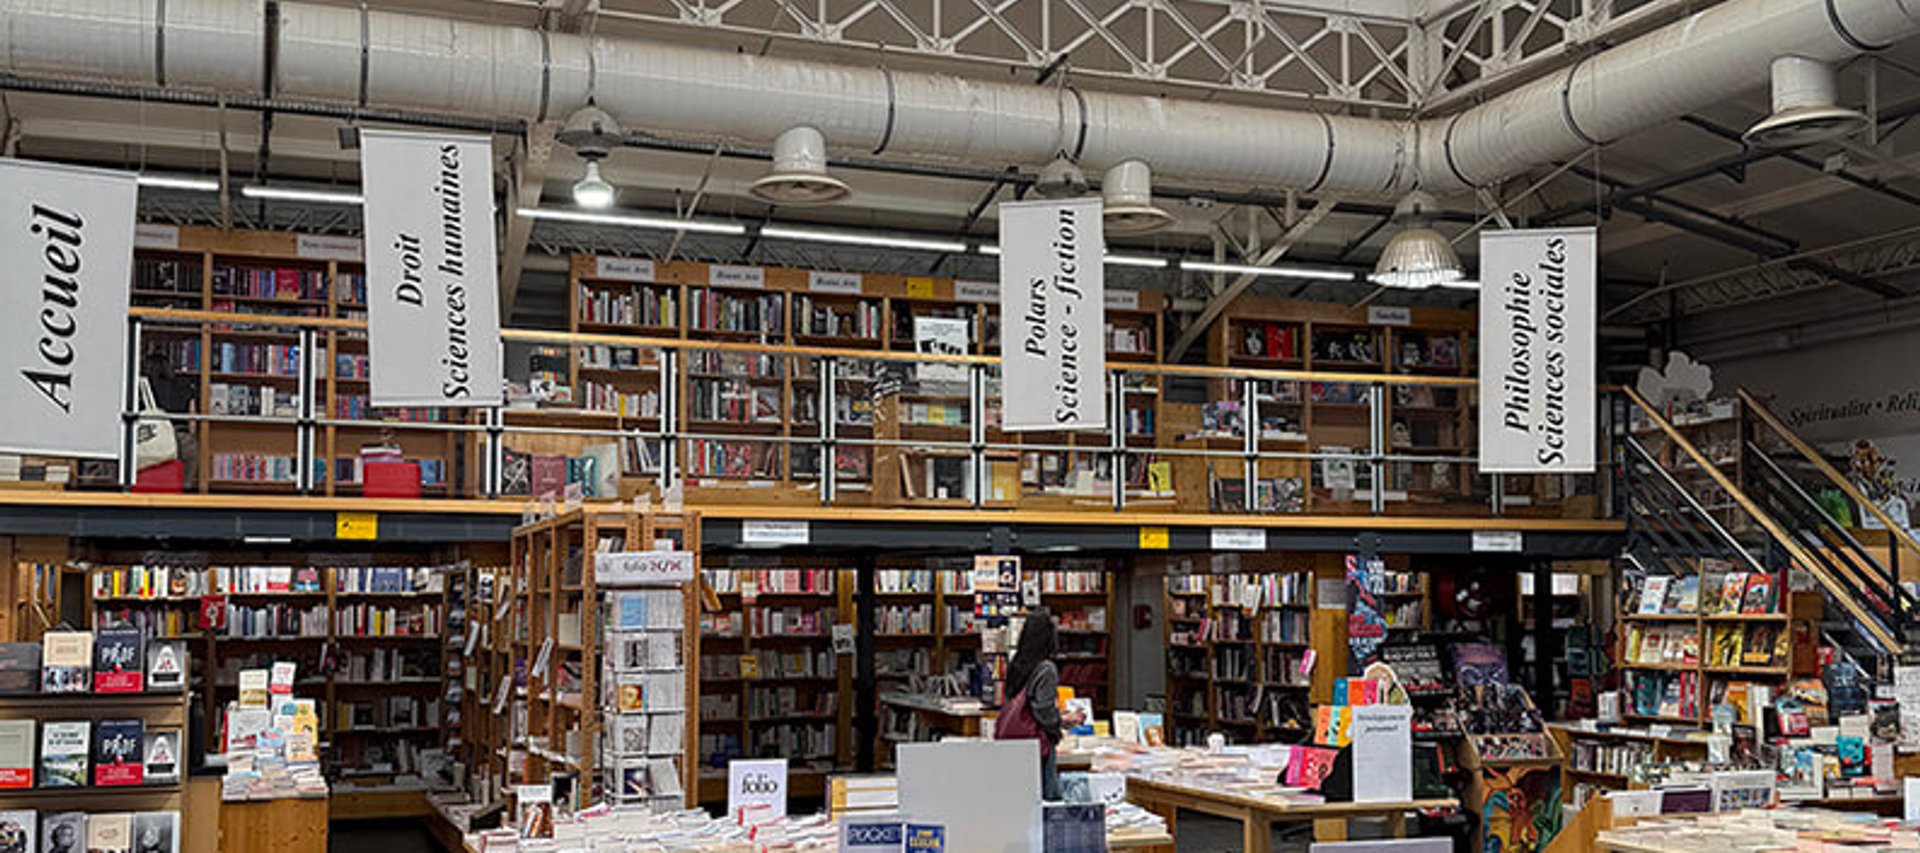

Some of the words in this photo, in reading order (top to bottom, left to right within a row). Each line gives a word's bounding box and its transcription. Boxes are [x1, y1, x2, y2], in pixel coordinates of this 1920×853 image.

[434, 144, 463, 276] humaines
[1053, 209, 1082, 300] fiction
[21, 204, 84, 414] Accueil
[394, 233, 423, 307] Droit
[1025, 278, 1046, 357] Polars
[1538, 237, 1567, 343] sociales
[441, 284, 471, 400] Sciences
[1055, 324, 1078, 424] Science
[1503, 272, 1536, 433] Philosophie
[1538, 351, 1566, 465] Sciences
[742, 772, 779, 795] folio
